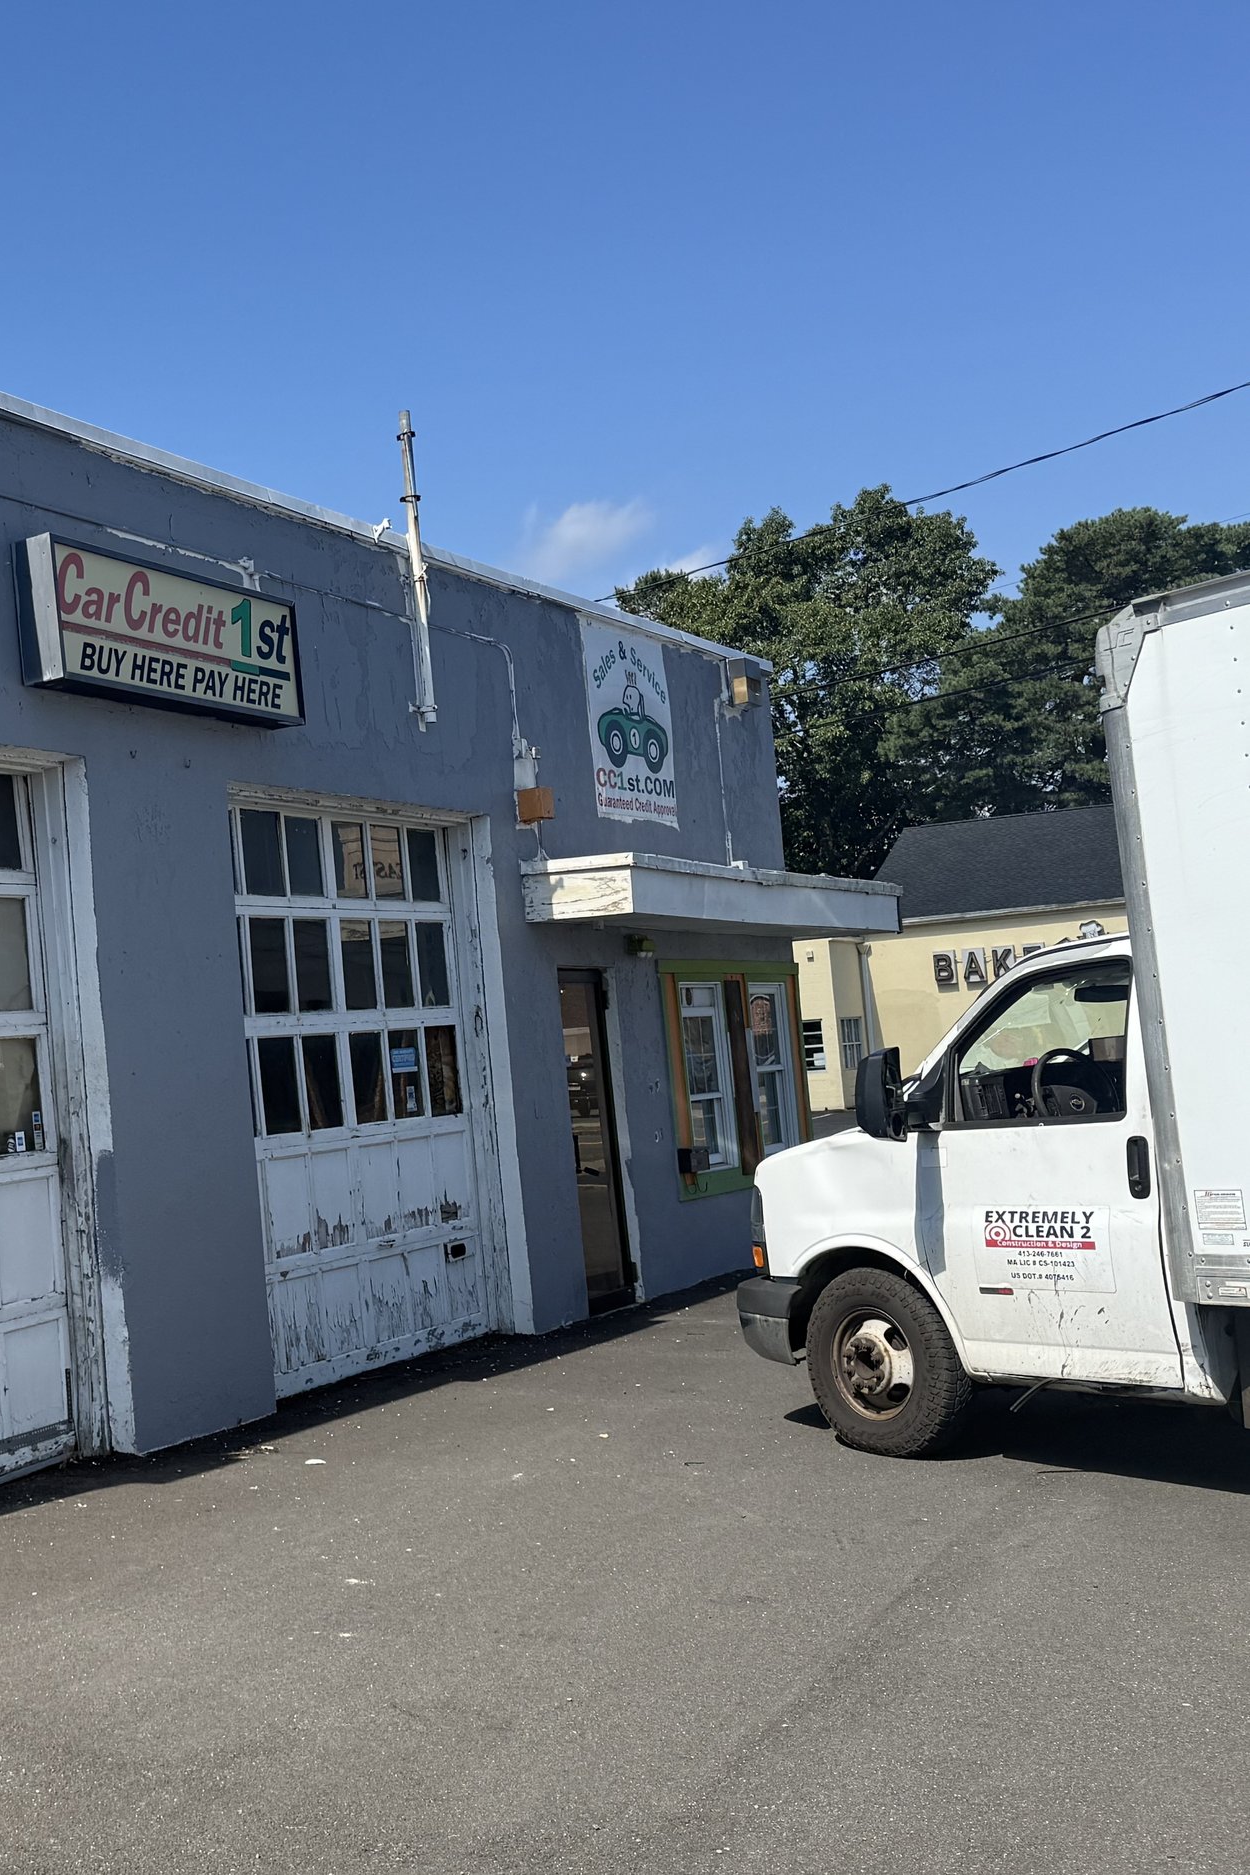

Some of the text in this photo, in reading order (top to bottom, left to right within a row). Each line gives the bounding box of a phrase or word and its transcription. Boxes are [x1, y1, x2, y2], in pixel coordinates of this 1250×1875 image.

[80, 641, 284, 710] BUY HERE PAY HERE
[593, 640, 666, 704] Sales & Service
[596, 767, 675, 798] CC1st.COM
[598, 792, 634, 811] Guaranteed
[635, 798, 653, 814] Credit
[985, 1210, 1095, 1225] EXTREMELY
[1012, 1225, 1092, 1239] CLEAN 2
[997, 1239, 1047, 1248] Construction
[1056, 1241, 1083, 1250] Design
